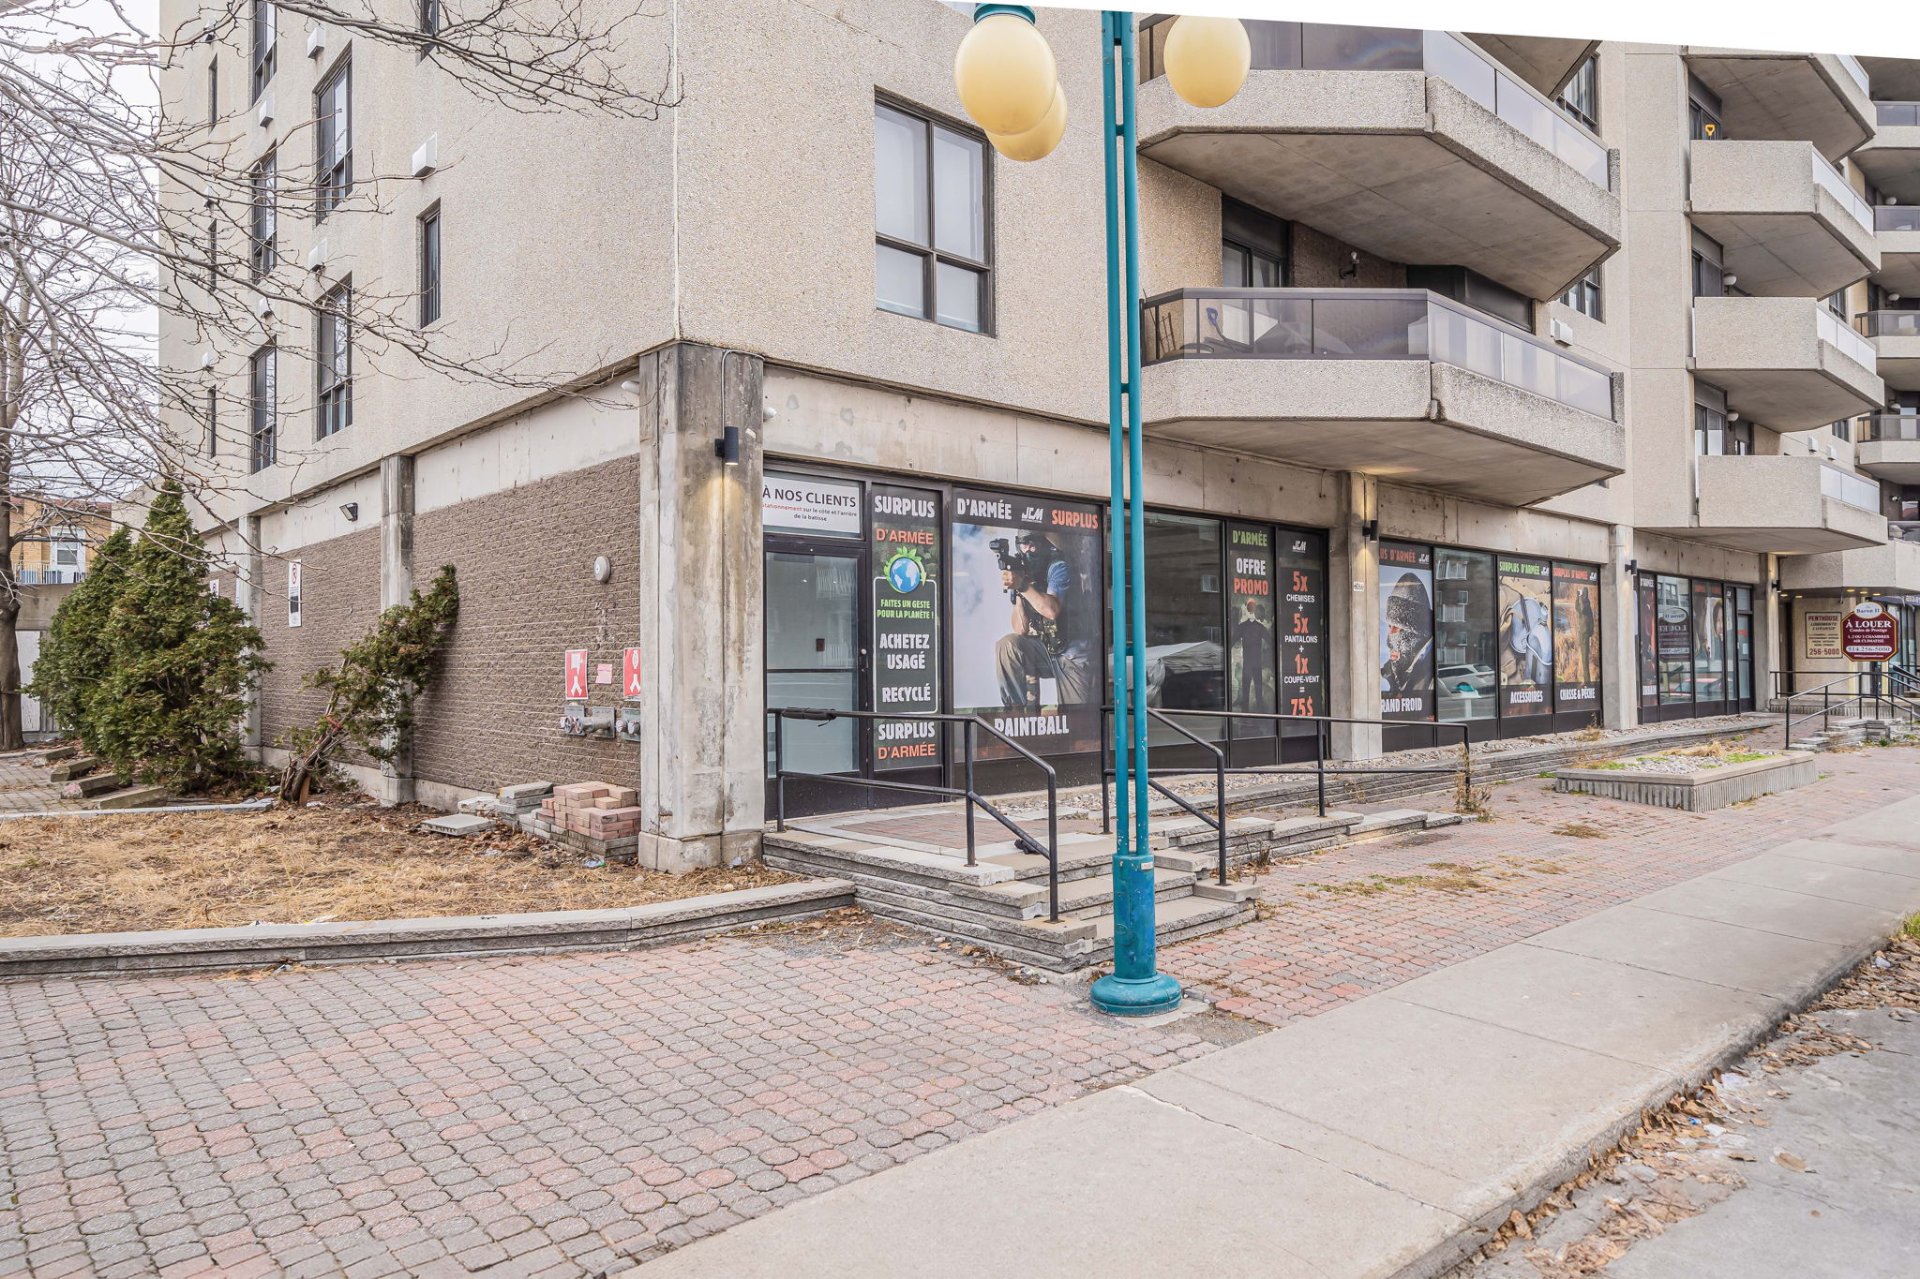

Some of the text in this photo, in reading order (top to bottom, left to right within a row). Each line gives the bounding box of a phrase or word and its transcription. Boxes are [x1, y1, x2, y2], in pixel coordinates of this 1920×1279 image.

[763, 485, 856, 508] À NOS CLIENTS
[874, 495, 935, 518] SURPLUS
[957, 498, 1013, 520] D'ARMÉE
[1051, 509, 1099, 529] SURPLUS
[876, 528, 934, 545] D'ARMÉE
[1232, 529, 1268, 547] D'ARMÉE
[1236, 557, 1266, 576] OFFRE
[1499, 561, 1519, 573] SURPLUS
[1233, 577, 1269, 596] PROMO
[1292, 570, 1308, 592] 5x
[880, 599, 930, 609] FAITES UN GESTE
[1286, 593, 1315, 603] CHEMISES
[877, 609, 895, 618] POUR
[895, 610, 903, 618] LA
[1293, 612, 1309, 634] 5x
[1846, 619, 1892, 628] À LOUER
[879, 633, 930, 649] ACHETEZ
[1284, 635, 1318, 643] PANTALONS
[887, 651, 926, 670] USAGÉ
[1295, 653, 1309, 674] 1x
[1283, 675, 1320, 684] COUPE-VENT
[882, 683, 931, 703] RECYCLÉ
[1510, 690, 1544, 704] ACCESSOIRES
[1560, 688, 1577, 700] CHASSE
[1290, 695, 1314, 717] 75$
[1381, 697, 1423, 713] RAND FROID
[878, 721, 936, 741] SURPLUS
[994, 715, 1070, 738] PAINTBALL
[877, 742, 937, 760] D'ARMÉE
